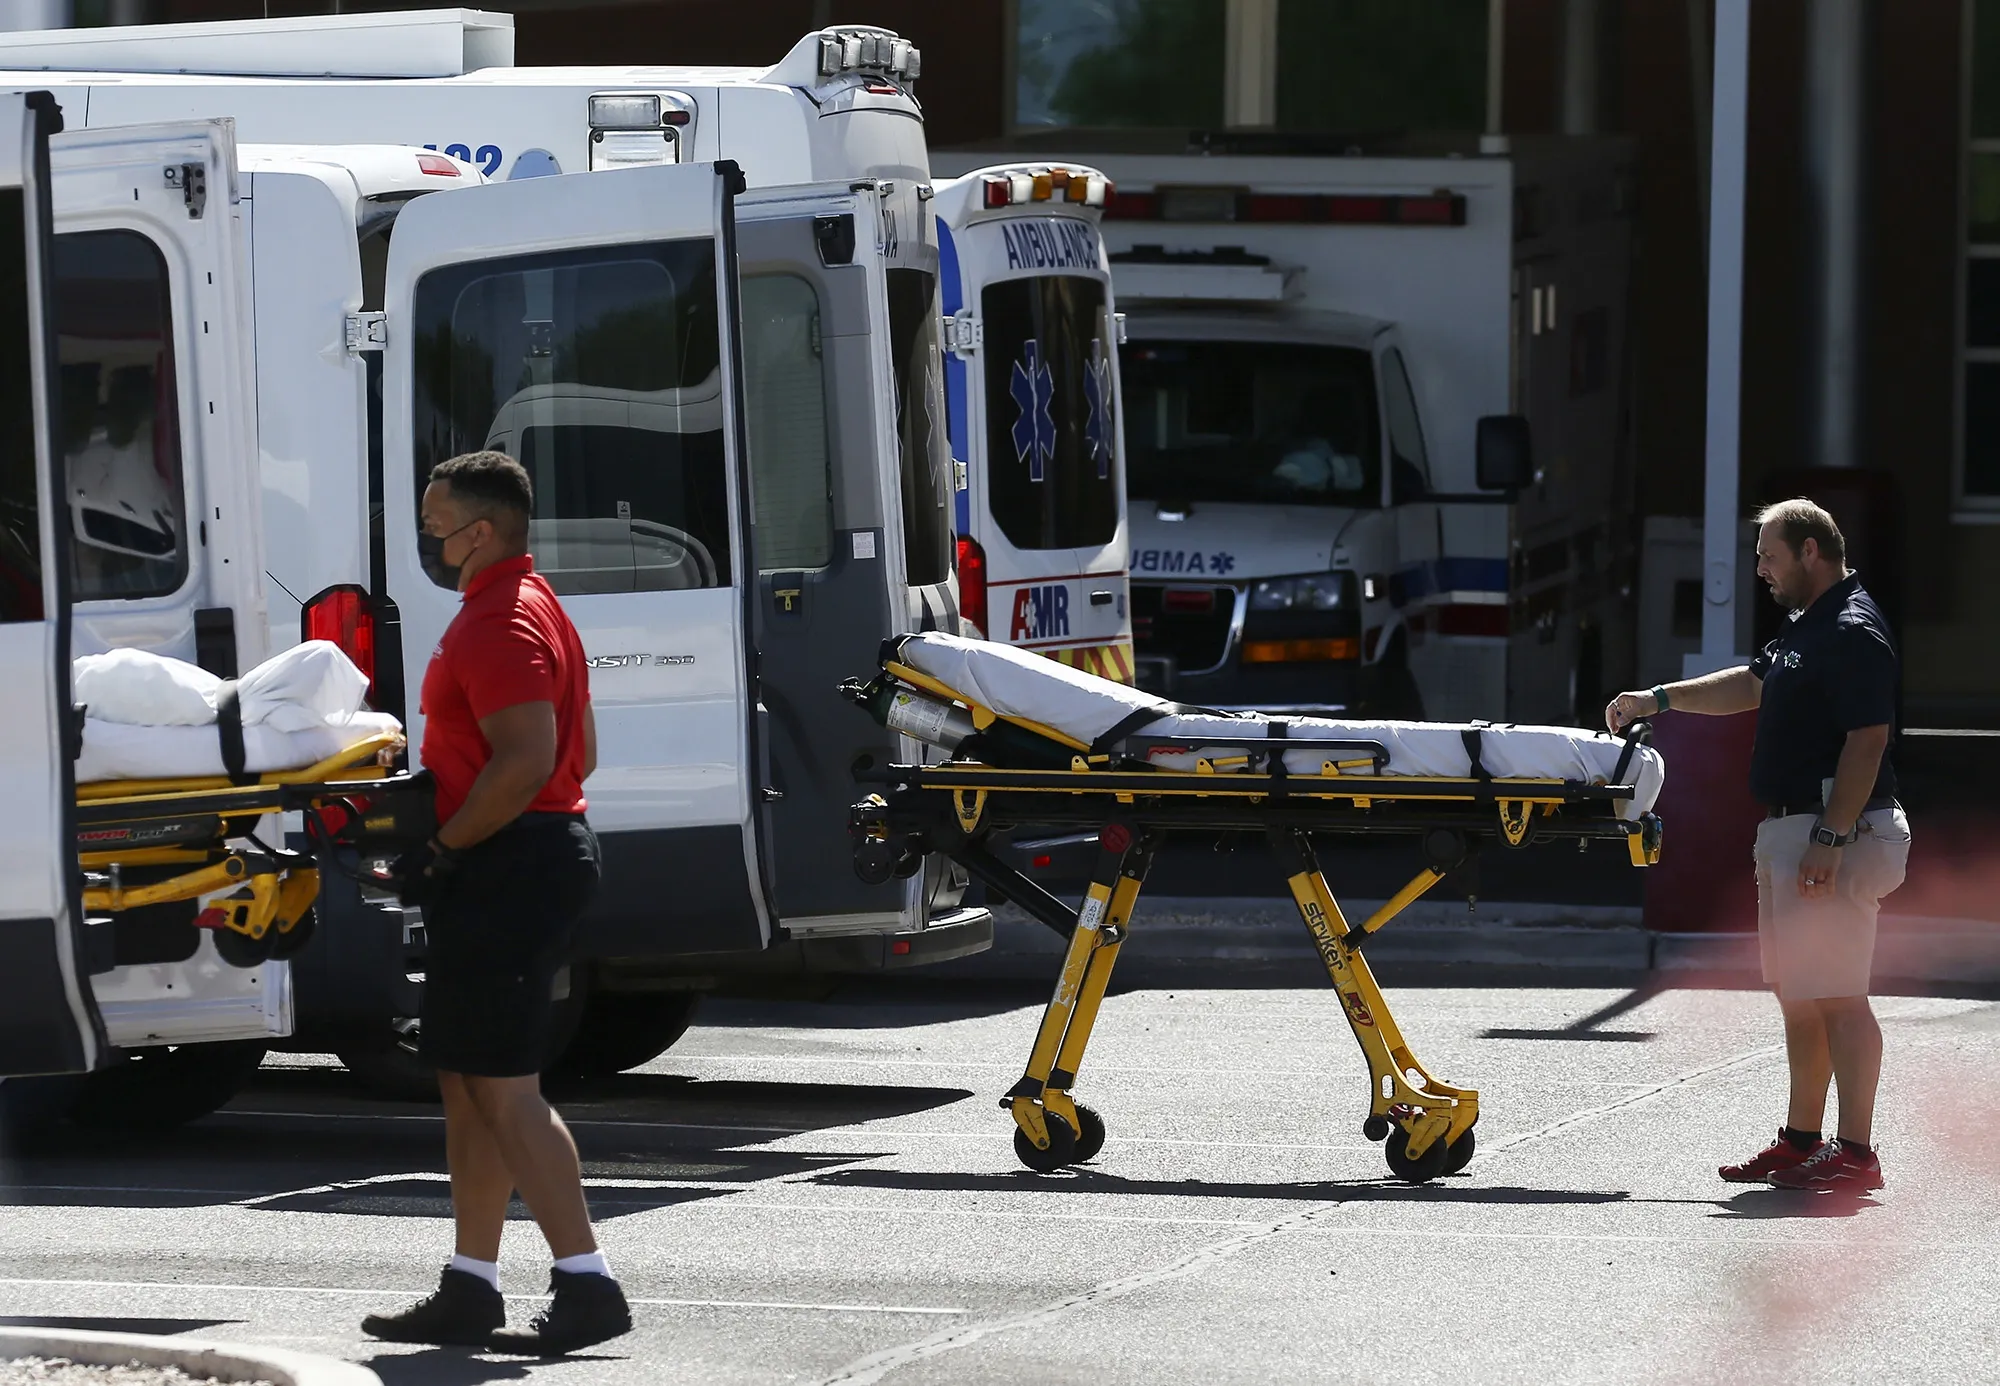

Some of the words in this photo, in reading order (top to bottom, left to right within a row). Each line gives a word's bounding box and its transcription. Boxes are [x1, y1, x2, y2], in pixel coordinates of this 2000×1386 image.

[1002, 222, 1098, 270] AMBULANCE
[1010, 584, 1070, 641] AMR
[655, 655, 695, 667] 350
[1303, 902, 1344, 970] stryker
